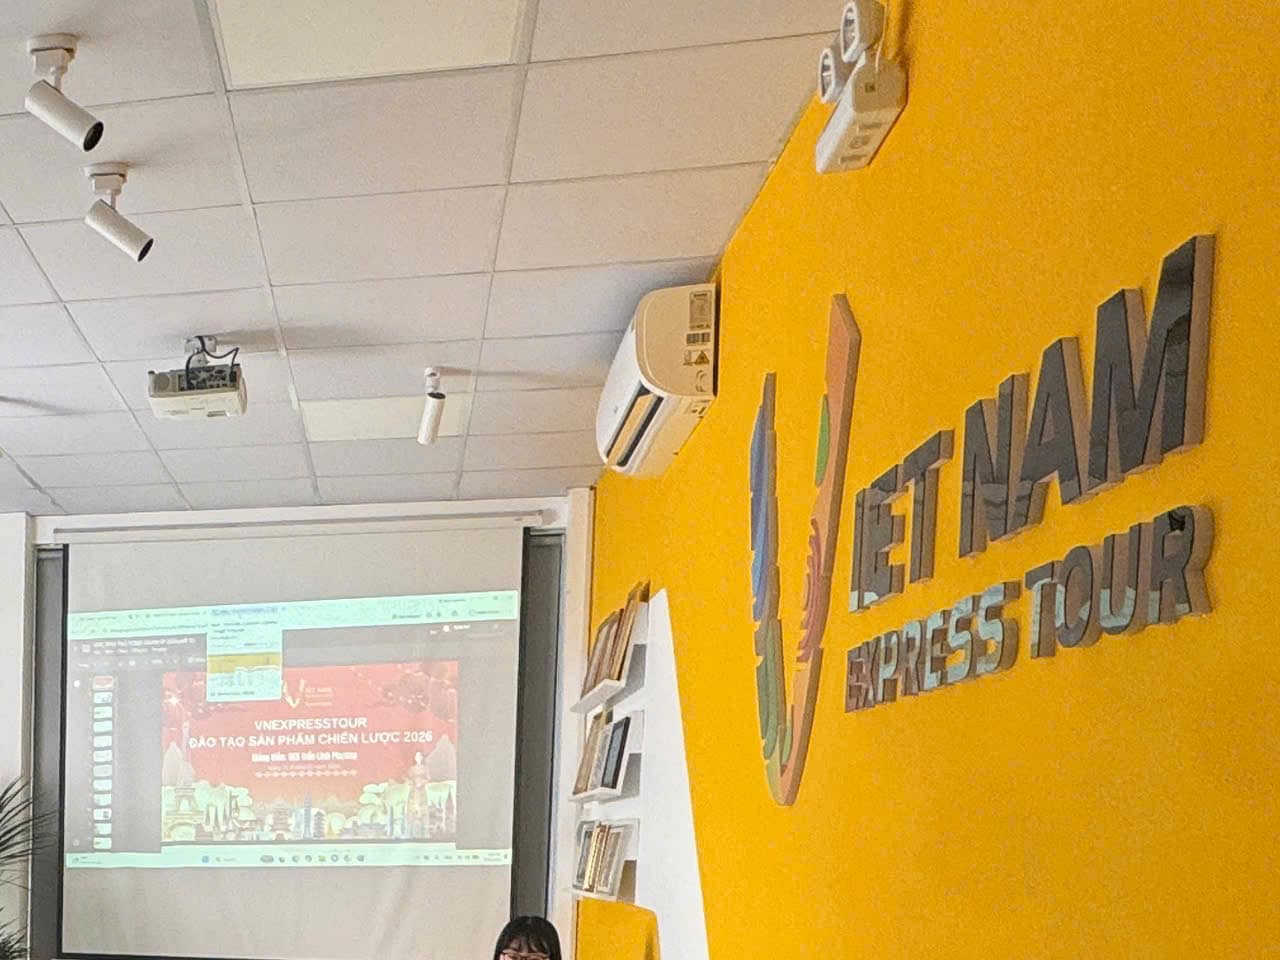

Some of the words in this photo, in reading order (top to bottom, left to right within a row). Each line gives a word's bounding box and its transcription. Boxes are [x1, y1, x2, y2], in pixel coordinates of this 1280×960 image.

[959, 234, 1216, 558] NAM
[845, 581, 1019, 713] EXPRESS
[1024, 504, 1214, 659] TOUR
[254, 717, 368, 730] VNEXPRESSTOUR
[403, 730, 433, 743] 2026
